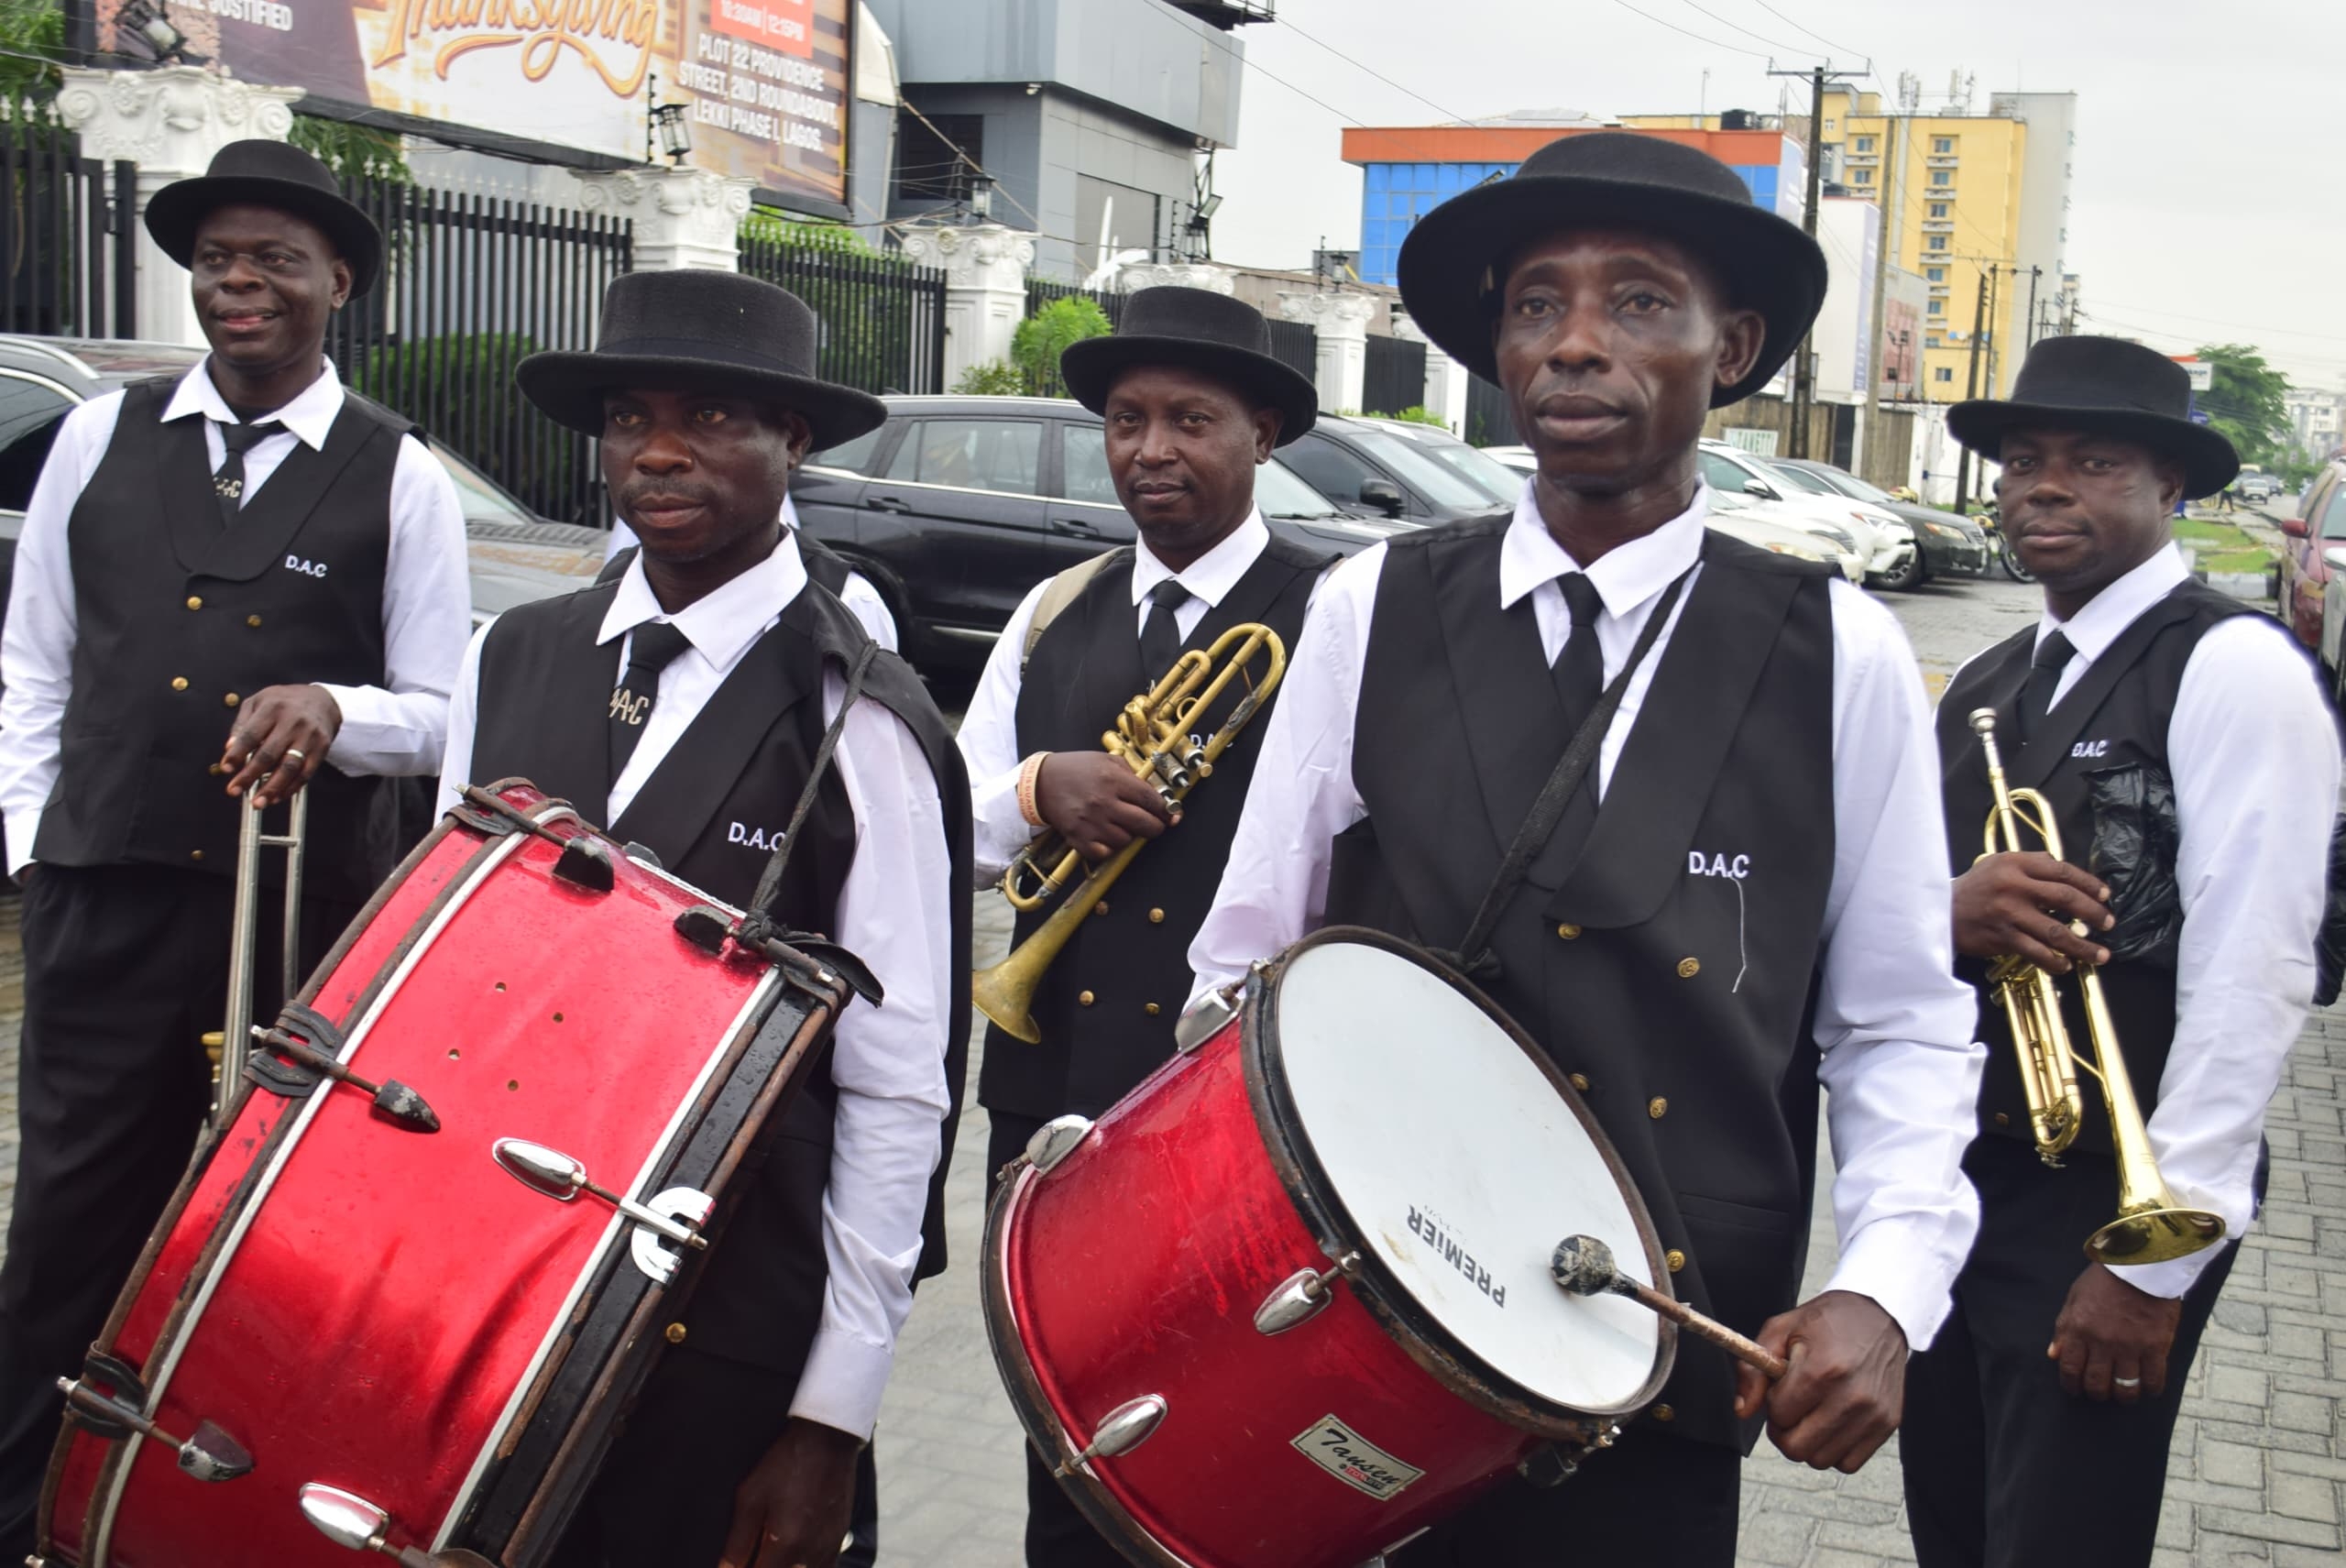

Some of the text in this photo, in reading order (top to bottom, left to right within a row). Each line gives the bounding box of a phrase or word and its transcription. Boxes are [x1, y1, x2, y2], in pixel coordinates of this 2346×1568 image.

[698, 33, 825, 92] PLOT 22 PROVIDENCE
[730, 74, 758, 104] 2ND
[694, 96, 731, 128] LEKKI
[731, 106, 772, 139] PHASE
[285, 554, 328, 578] D.A.C
[1689, 850, 1749, 879] D.A.C
[1321, 1428, 1402, 1485] Tansen
